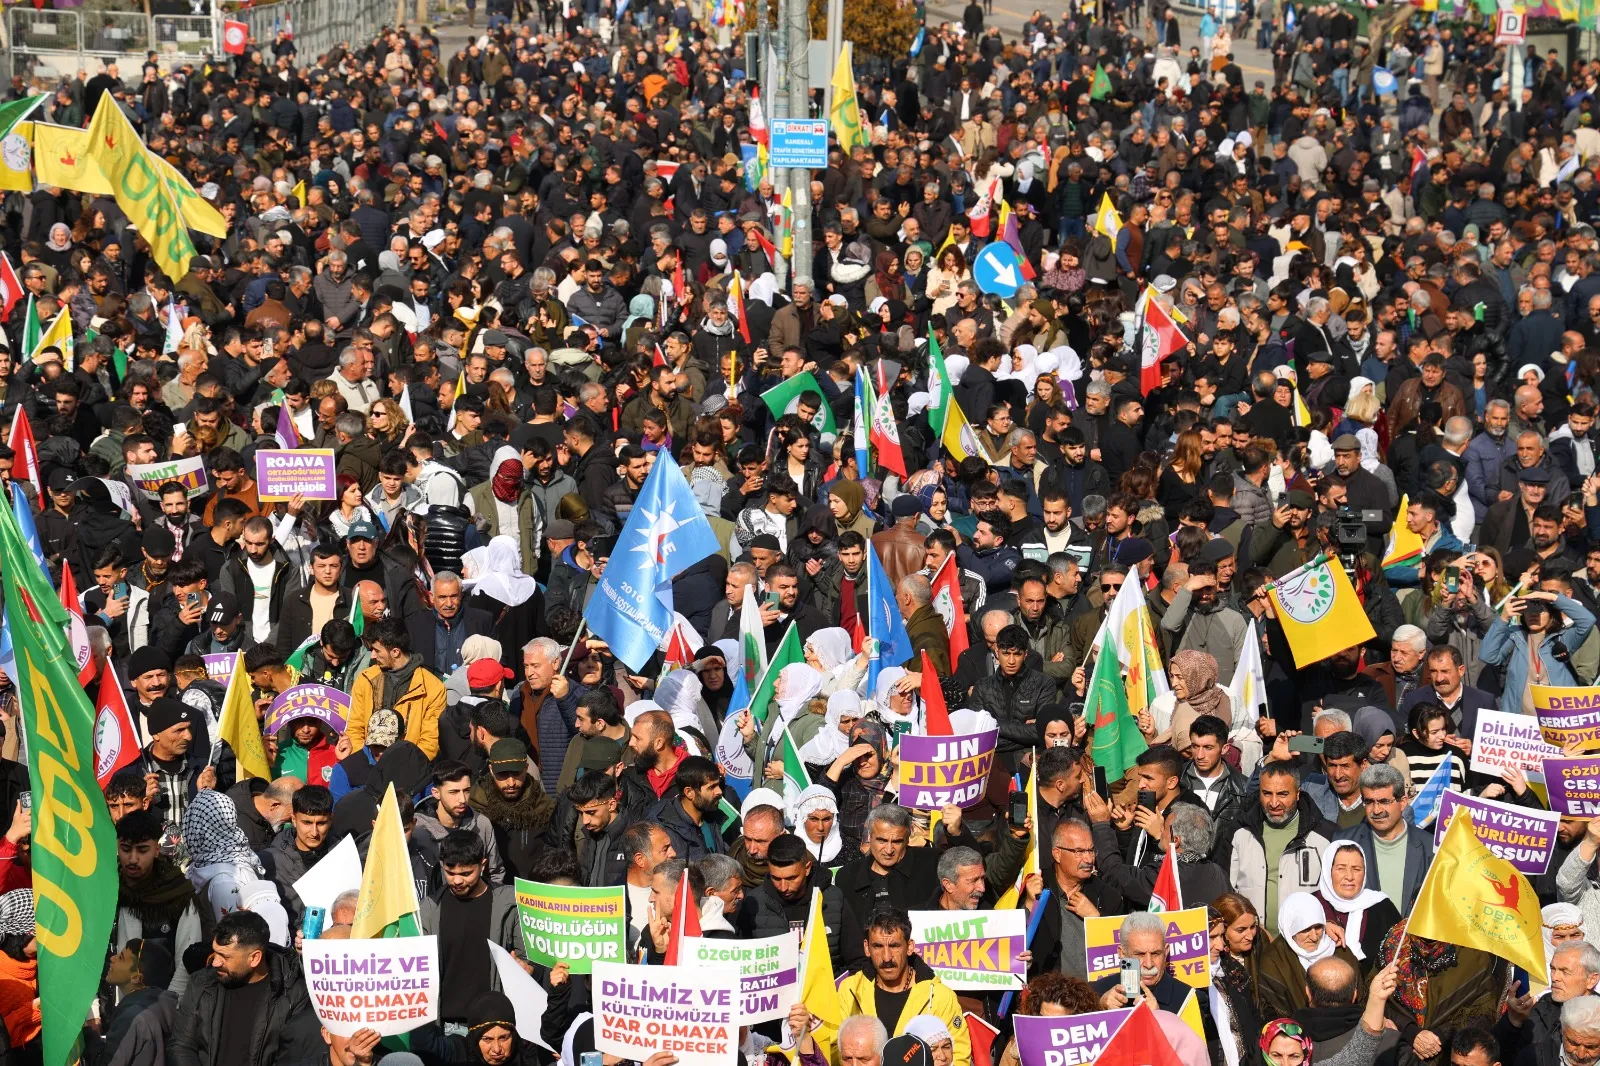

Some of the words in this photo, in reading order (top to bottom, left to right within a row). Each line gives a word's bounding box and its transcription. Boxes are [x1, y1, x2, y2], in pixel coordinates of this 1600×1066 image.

[1506, 16, 1518, 31] D
[140, 464, 178, 480] UMUT
[266, 456, 325, 468] ROJAVA
[267, 482, 326, 495] EŞİTLİĞİDİR
[620, 582, 645, 603] 2010
[1482, 720, 1542, 740] DİLİMİZ
[932, 737, 979, 762] JIN
[1480, 745, 1506, 758] VAR
[909, 752, 992, 784] JIYAN
[1564, 779, 1600, 790] CES
[1490, 811, 1547, 832] YÜZYIL
[519, 895, 570, 912] KADINLARIN
[572, 902, 618, 915] DİRENİŞİ
[1483, 905, 1515, 922] DBP
[522, 911, 618, 937] ÖZGÜRLÜĞÜN
[924, 916, 988, 943] UMUT
[525, 931, 619, 960] YOLUDUR
[697, 945, 752, 961] ÖZGÜR
[755, 943, 780, 960] BİR
[923, 937, 1011, 972] HAKKI
[310, 953, 393, 975] DİLİMİZ
[398, 955, 430, 973] VE
[754, 959, 780, 975] İÇİN
[313, 976, 430, 992] KÜLTÜRÜMÜZLE
[935, 970, 1013, 986] YGULANSIN
[315, 993, 346, 1008] VAR
[350, 992, 429, 1008] OLMAYA
[601, 977, 693, 1005] DİLİMİZ
[700, 989, 731, 1006] VE
[319, 1008, 361, 1023] DEVAM
[366, 1007, 428, 1023] EDECEK
[601, 1000, 730, 1024] KÜLTÜRÜMÜZLE
[602, 1014, 640, 1033] VAR
[646, 1022, 728, 1040] OLMAYA
[1050, 1021, 1108, 1047] DEM
[602, 1028, 657, 1049] DEVAM
[662, 1039, 728, 1055] EDECEK
[903, 1043, 922, 1063] STIHL
